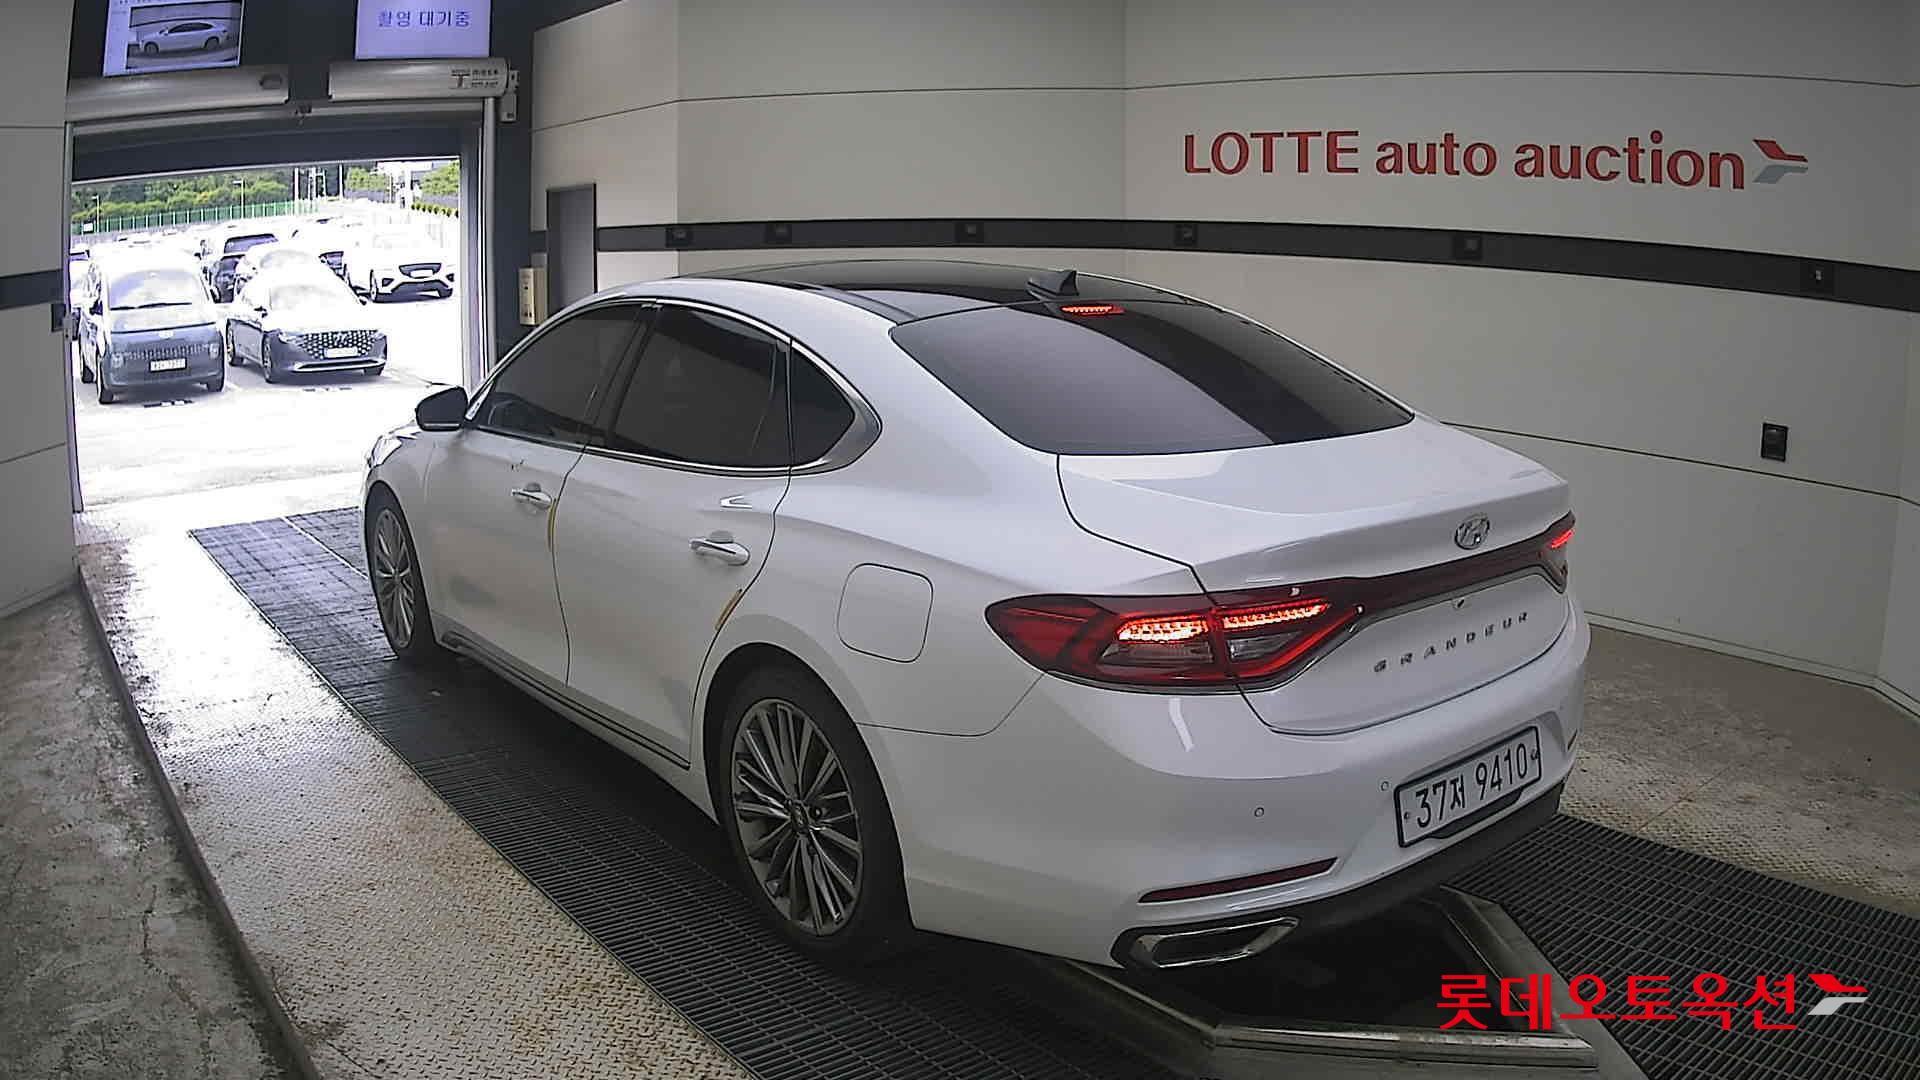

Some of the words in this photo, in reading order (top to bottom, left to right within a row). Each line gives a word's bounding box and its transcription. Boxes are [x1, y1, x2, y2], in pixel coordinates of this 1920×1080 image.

[419, 10, 471, 28] 대기중
[1184, 130, 1360, 174] LOTTE
[1375, 132, 1498, 177] auto
[1513, 130, 1746, 190] auction
[1373, 611, 1528, 674] GRANDEUR
[1415, 774, 1466, 828] 37저
[1475, 742, 1528, 801] 9410
